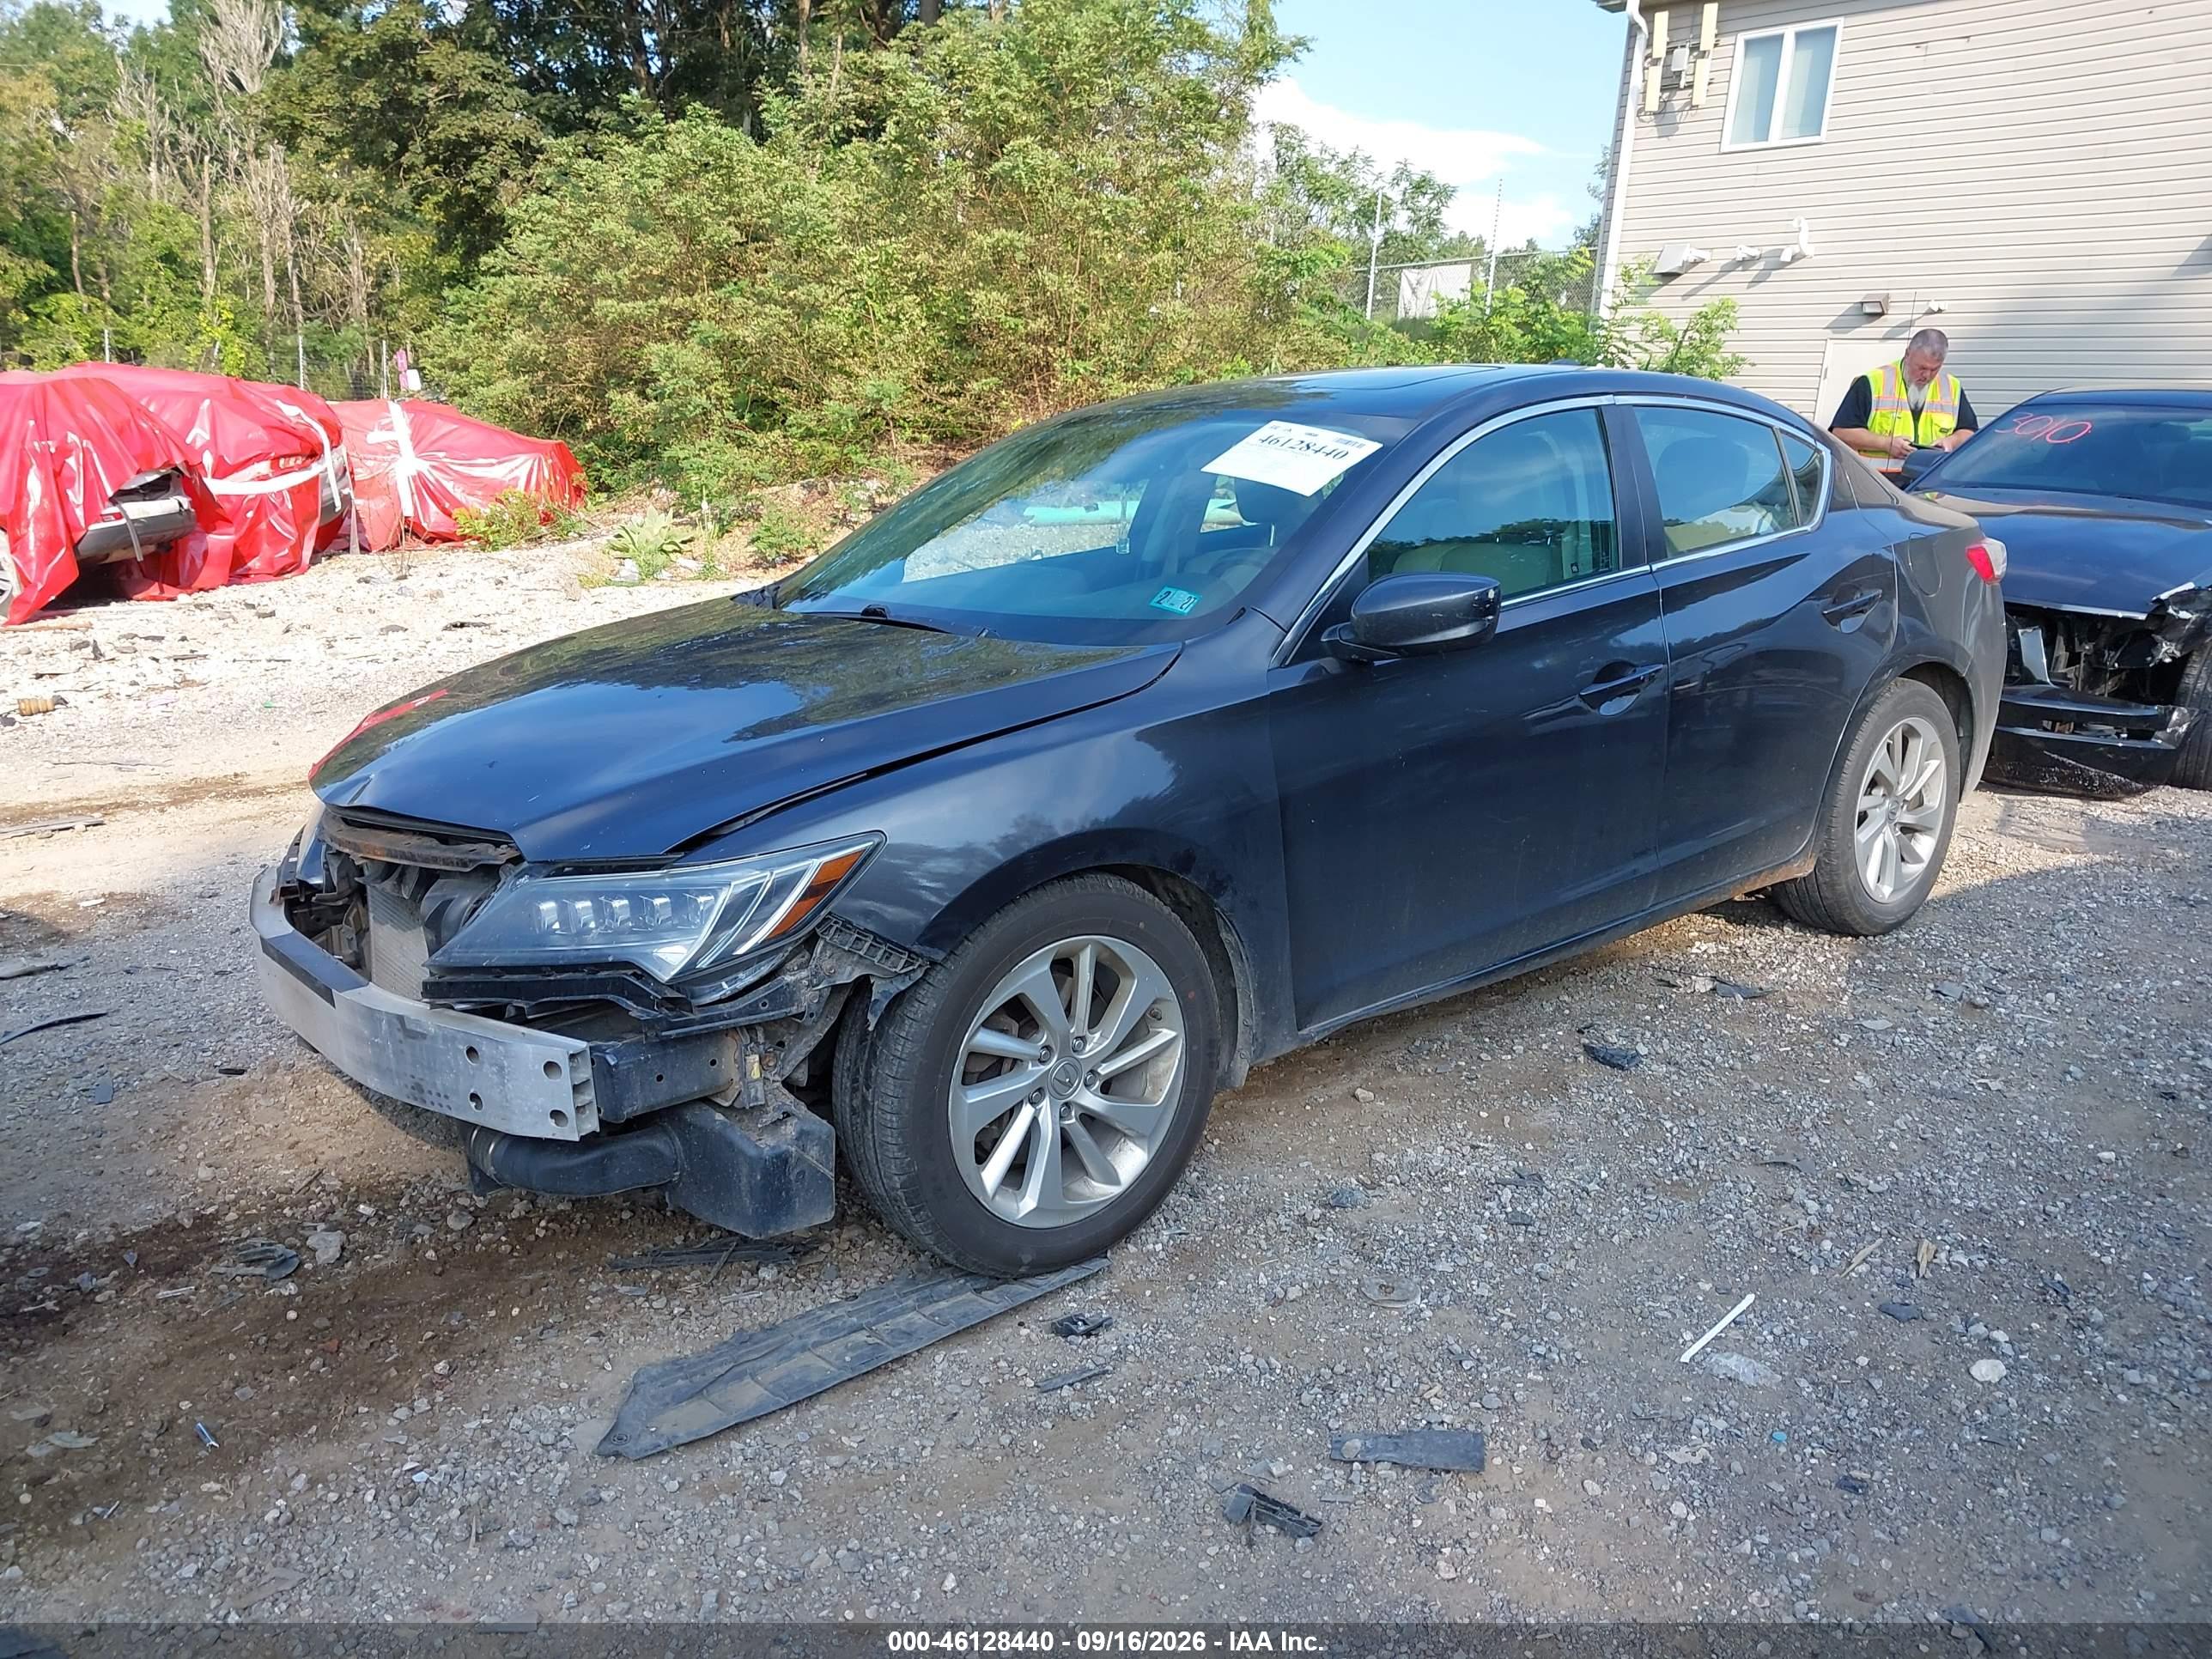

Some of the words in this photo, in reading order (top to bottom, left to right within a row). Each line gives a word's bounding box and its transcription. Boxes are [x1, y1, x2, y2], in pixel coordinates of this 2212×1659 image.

[1995, 411, 2092, 443] 3010
[1259, 434, 1350, 459] 46128440
[1180, 595, 1197, 611] 27
